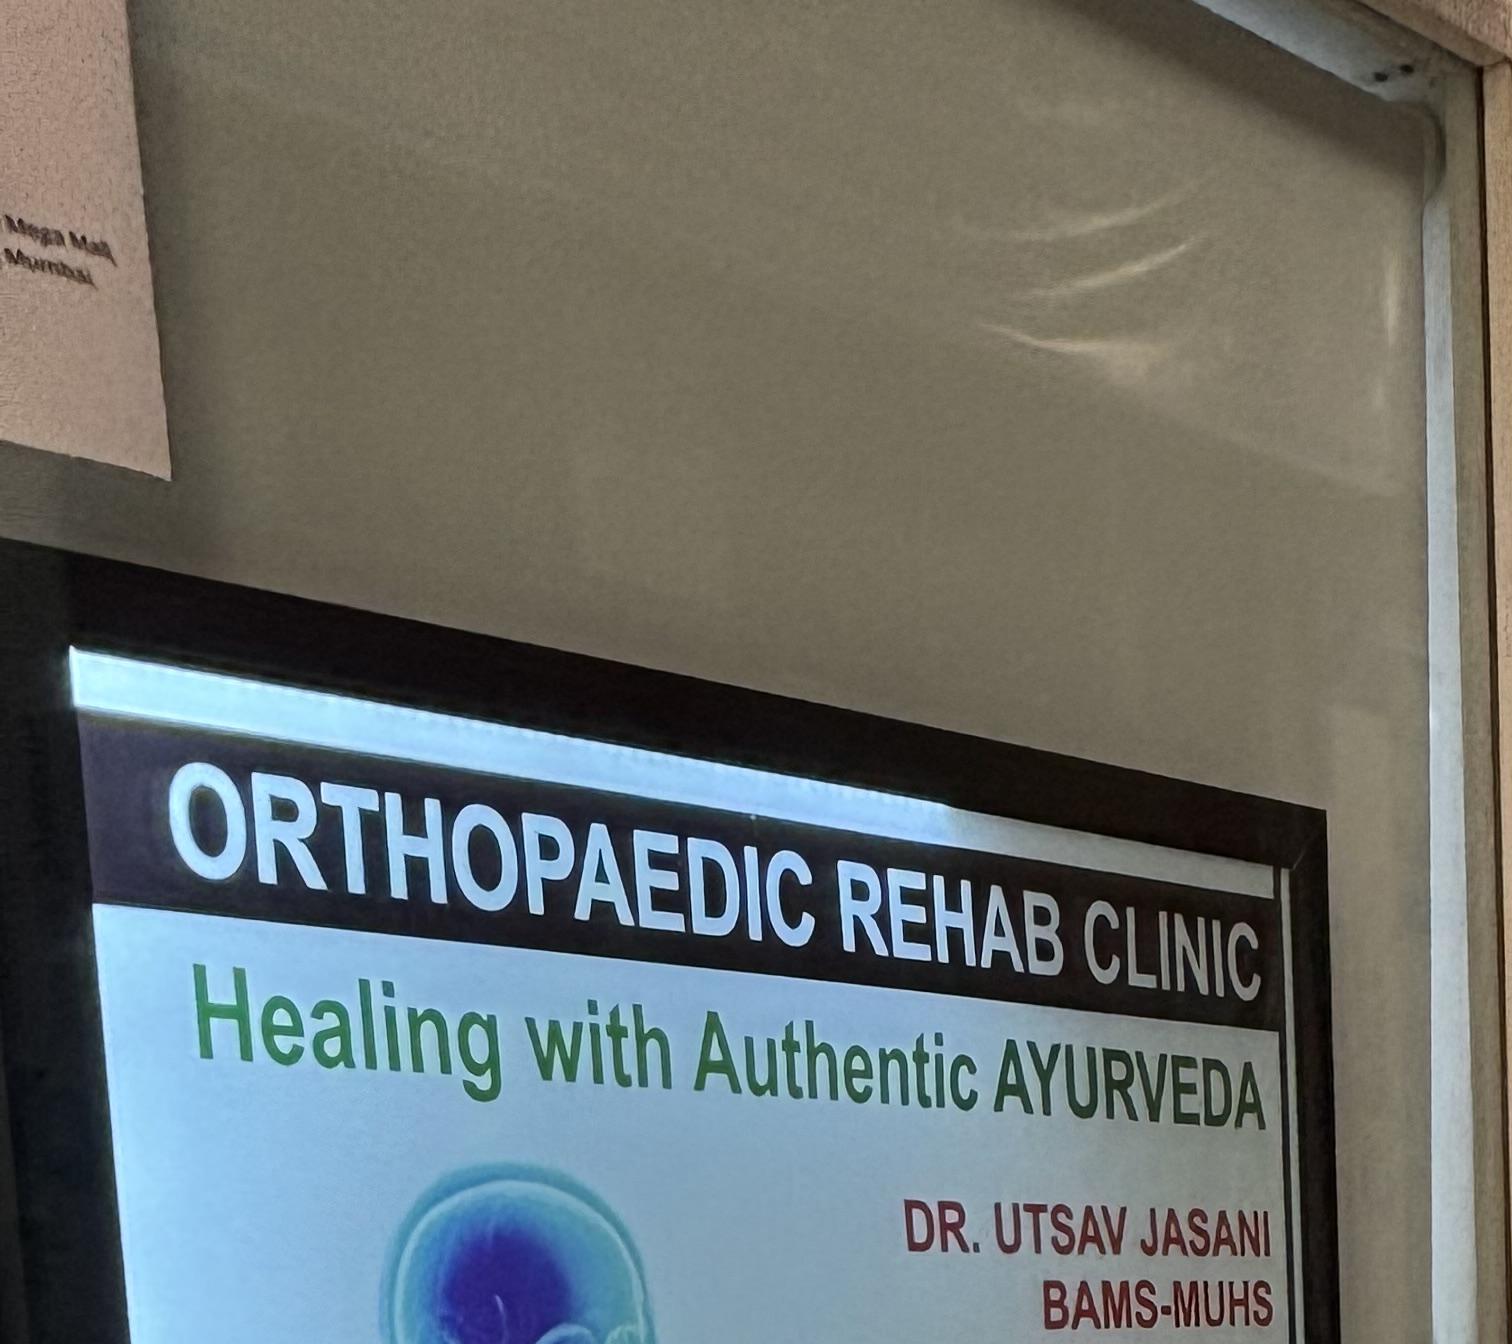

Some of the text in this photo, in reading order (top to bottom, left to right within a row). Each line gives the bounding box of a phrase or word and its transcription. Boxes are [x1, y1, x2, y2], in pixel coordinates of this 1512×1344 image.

[168, 761, 1262, 1001] ORTHOPAEDIC REHAB CLINIC
[193, 963, 1267, 1131] Healing with Authentic AYURVEDA
[903, 1198, 1272, 1258] DR. UTSAV JASANI
[1042, 1279, 1275, 1331] BAMS-MUHS
